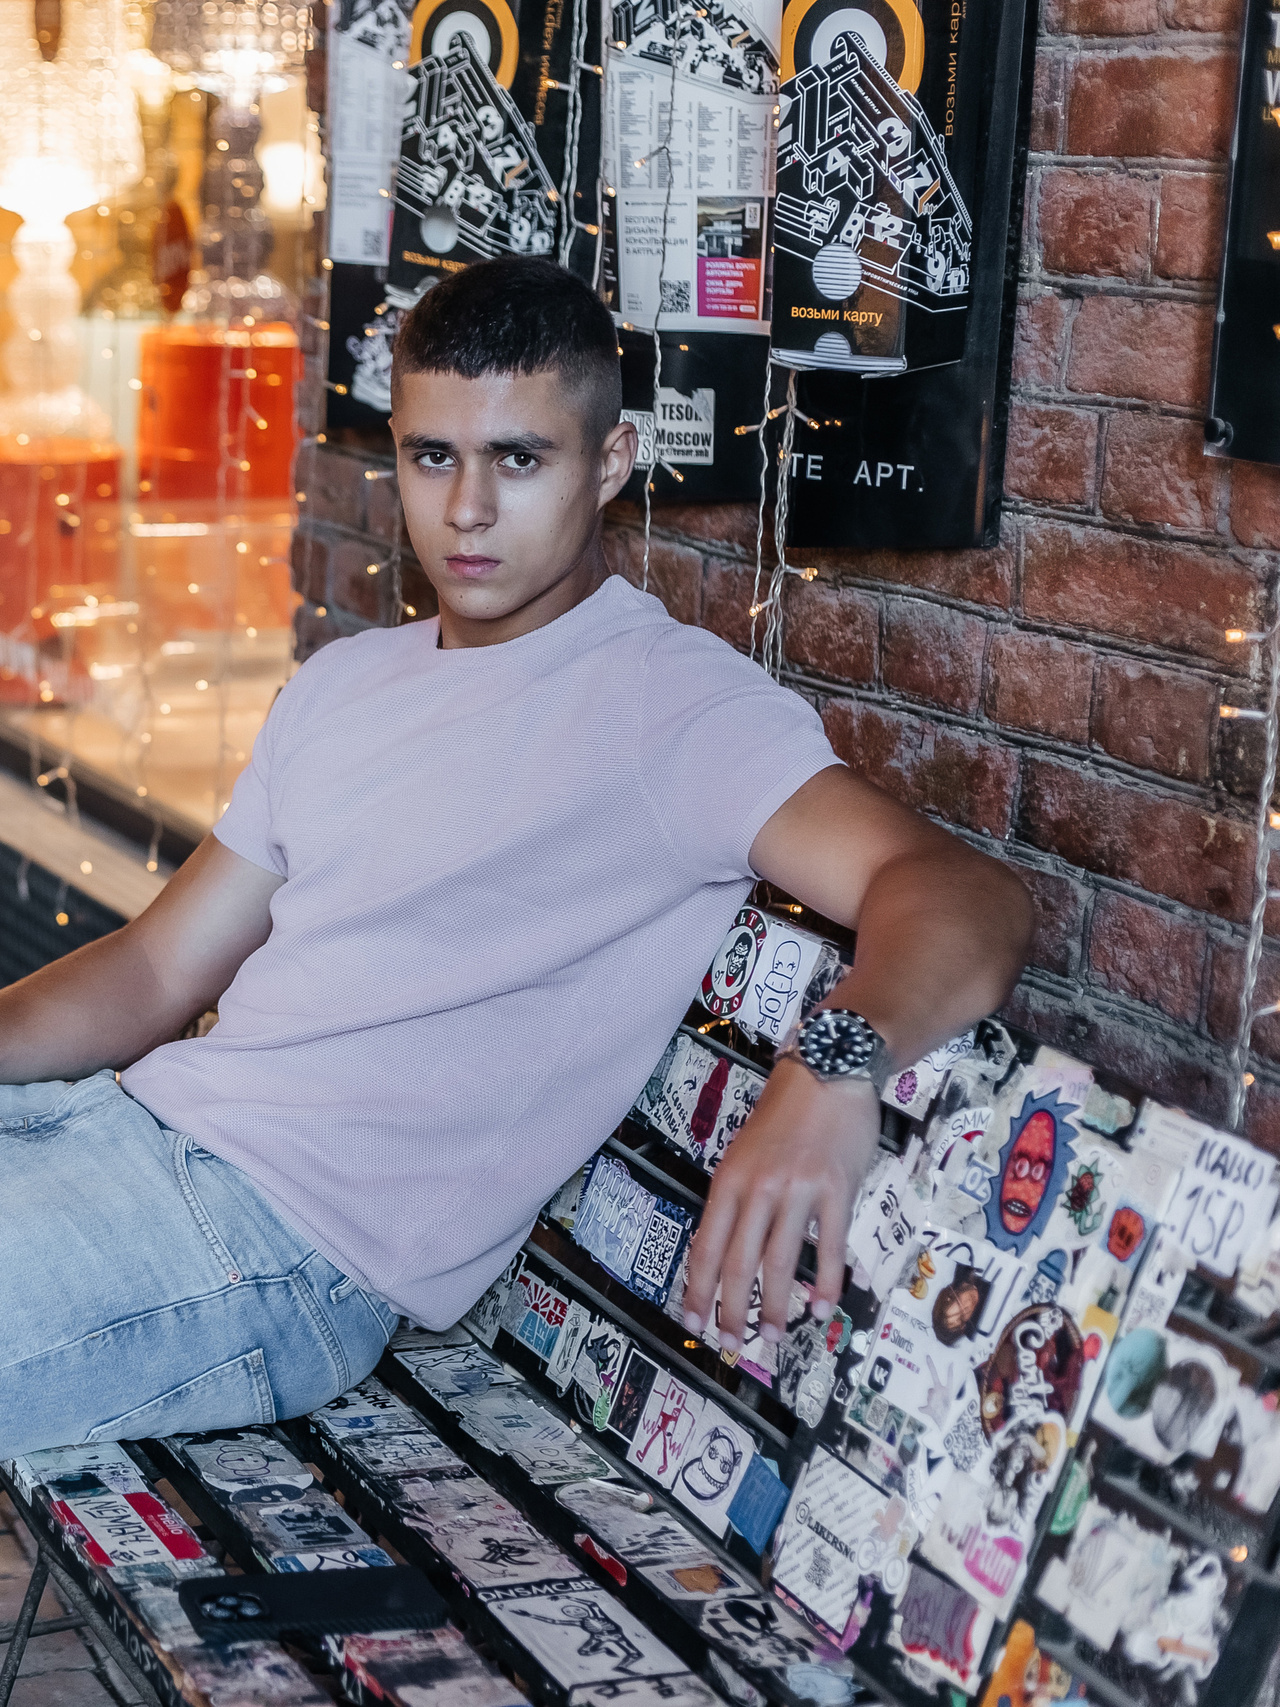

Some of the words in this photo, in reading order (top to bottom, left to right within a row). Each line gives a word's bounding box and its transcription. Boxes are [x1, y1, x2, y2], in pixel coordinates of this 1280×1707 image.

[945, 52, 958, 136] возьми
[791, 306, 840, 321] возьми
[843, 308, 884, 327] карту
[951, 1110, 992, 1138] SMM
[890, 1328, 915, 1354] Shorts
[157, 1513, 184, 1536] Hello
